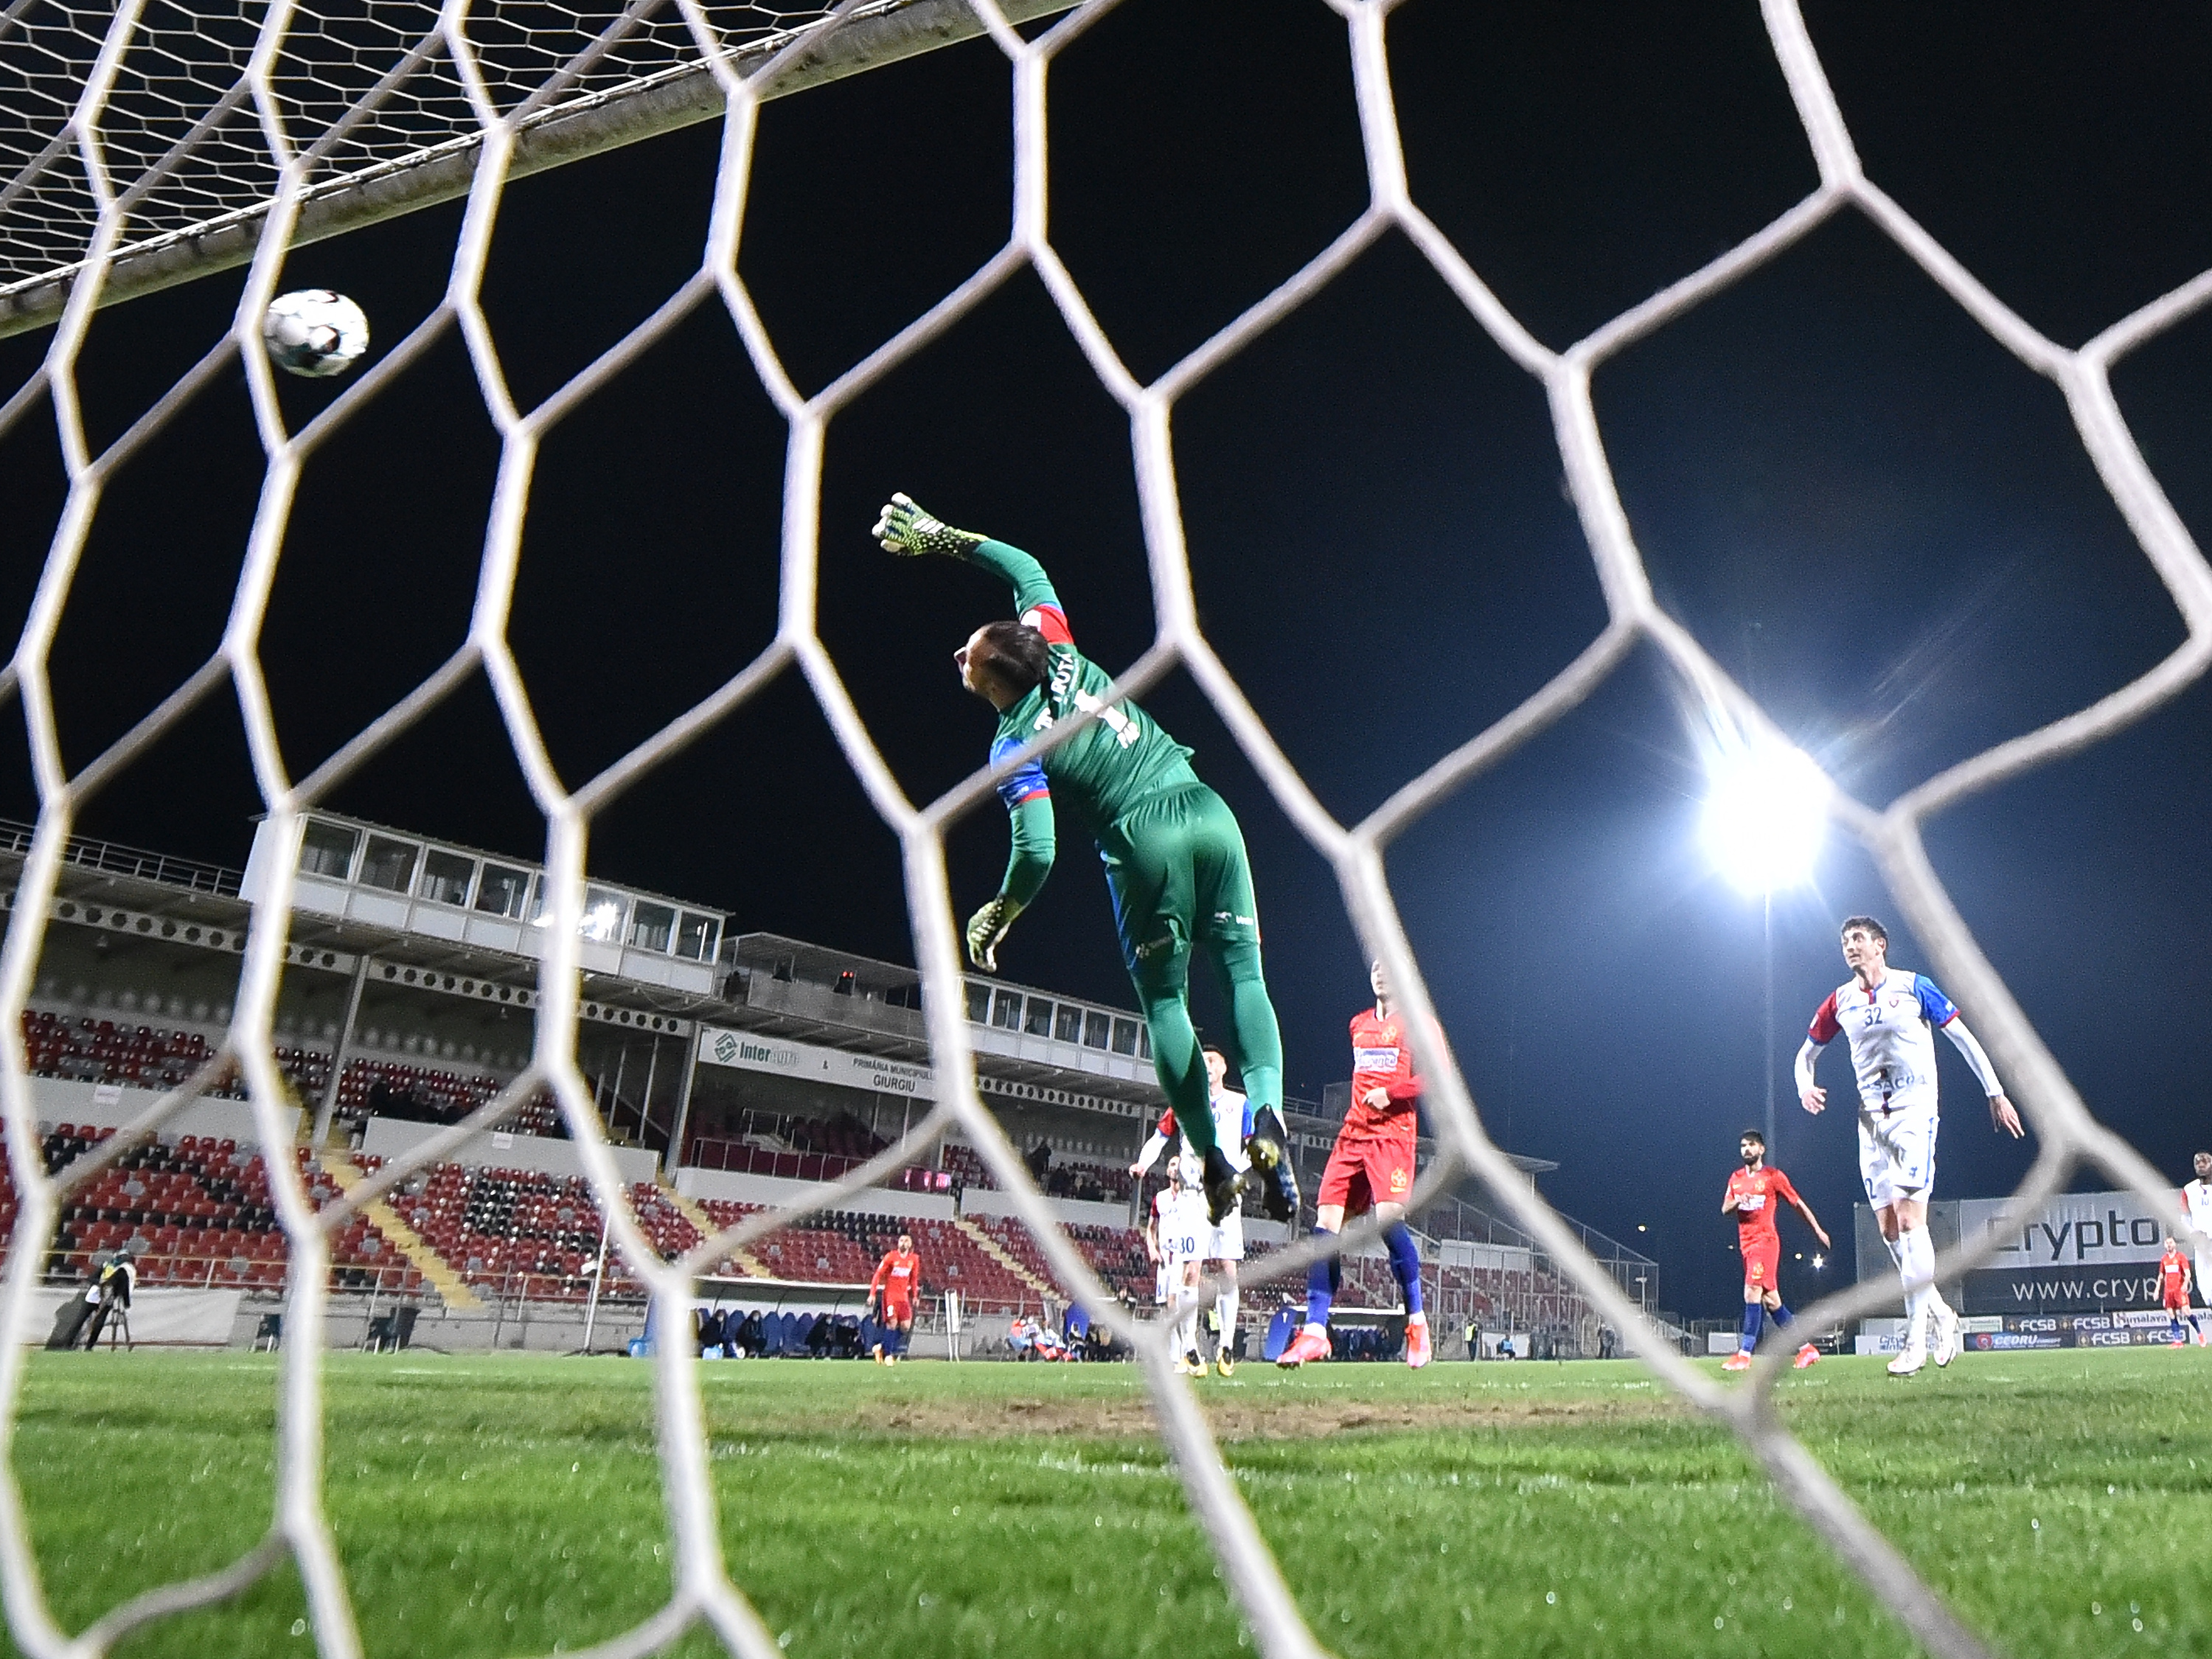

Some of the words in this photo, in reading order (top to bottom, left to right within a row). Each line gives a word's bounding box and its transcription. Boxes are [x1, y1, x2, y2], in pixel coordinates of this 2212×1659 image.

[1864, 1007, 1883, 1027] 32
[874, 1074, 915, 1092] GIURGIU
[2020, 1319, 2056, 1332] FCSB
[2073, 1317, 2110, 1329] FCSB
[2092, 1332, 2130, 1345] FCSB
